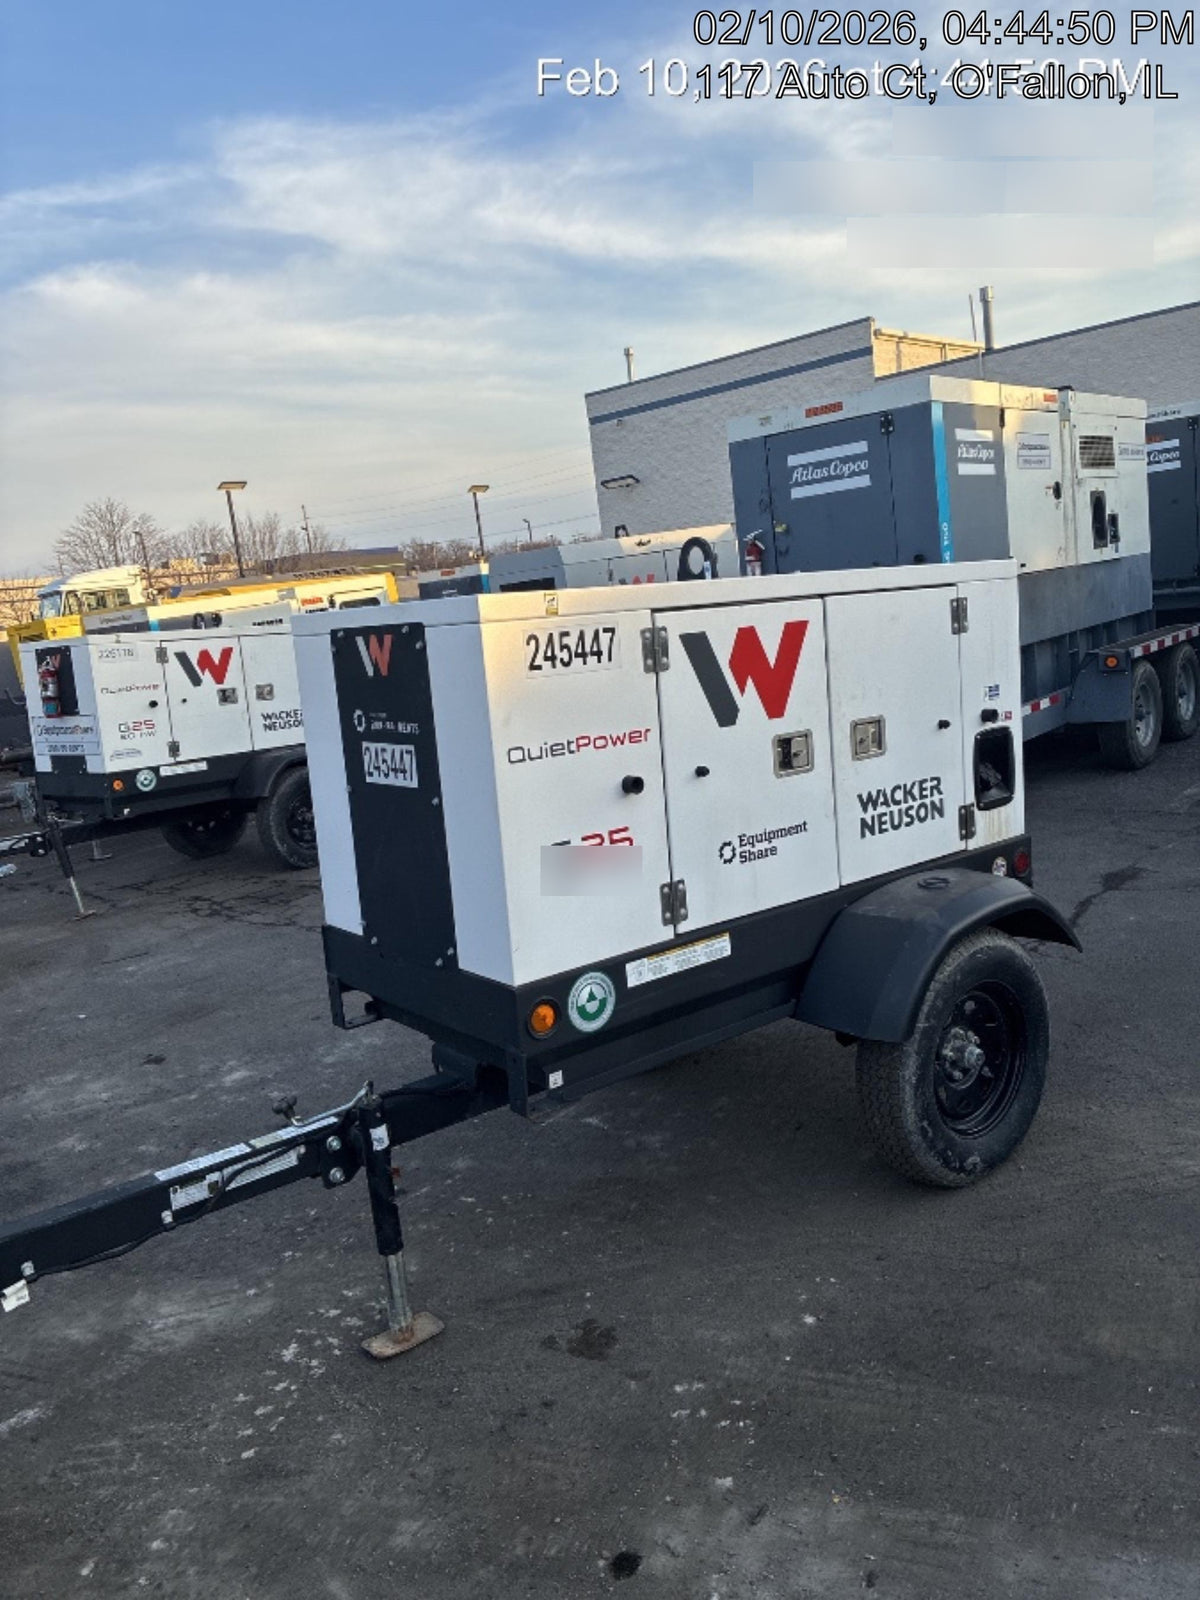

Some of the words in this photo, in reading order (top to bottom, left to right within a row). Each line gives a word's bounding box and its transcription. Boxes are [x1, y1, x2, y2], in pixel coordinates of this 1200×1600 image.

[525, 626, 616, 671] 245447
[261, 708, 303, 722] WACKE
[263, 719, 304, 732] NEUSO
[507, 727, 652, 764] QuietPower
[363, 746, 415, 783] 245447
[857, 776, 944, 814] WACKER
[737, 820, 808, 848] Equipment
[859, 798, 946, 839] NEUSON
[739, 845, 778, 864] Share
